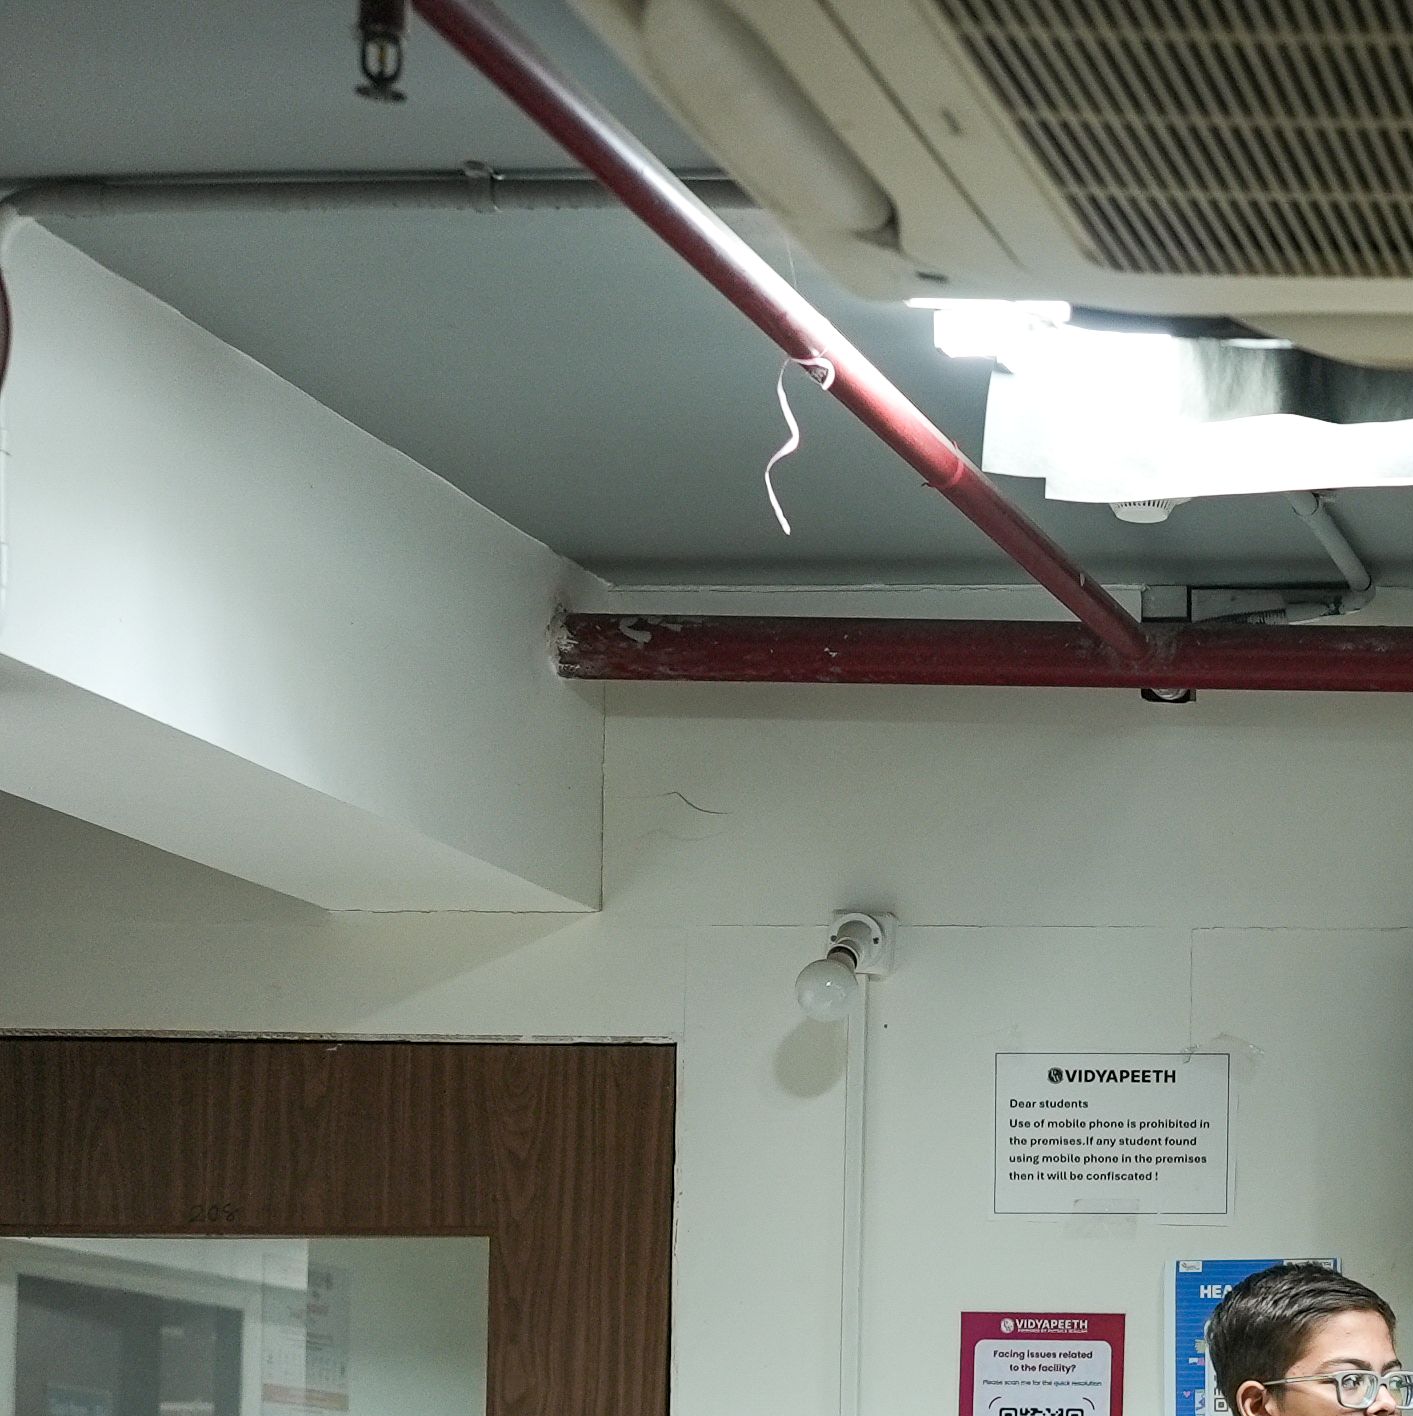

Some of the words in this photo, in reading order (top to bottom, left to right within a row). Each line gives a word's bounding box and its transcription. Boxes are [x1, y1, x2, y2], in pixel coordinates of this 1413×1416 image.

[1065, 1069, 1176, 1083] VIDYAPEETH
[1009, 1099, 1037, 1109] Dear
[1039, 1099, 1089, 1109] students
[1009, 1119, 1031, 1129] Use
[1033, 1119, 1045, 1129] of
[1047, 1119, 1086, 1129] mobile
[1088, 1119, 1124, 1131] phone
[1127, 1119, 1137, 1129] is
[1139, 1119, 1197, 1131] prohibited
[1199, 1119, 1210, 1129] in
[1009, 1136, 1028, 1146] the
[1096, 1137, 1116, 1148] any
[1118, 1136, 1162, 1146] student
[1164, 1136, 1197, 1146] found
[1009, 1154, 1039, 1165] using
[1041, 1154, 1081, 1164] mobile
[1083, 1154, 1119, 1166] phone
[1121, 1154, 1132, 1164] in
[1134, 1154, 1152, 1164] the
[1155, 1154, 1207, 1166] premises
[1009, 1171, 1034, 1181] then
[1037, 1171, 1045, 1181] it
[1047, 1171, 1067, 1181] will
[1069, 1171, 1084, 1181] be
[1086, 1171, 1152, 1181] confiscated
[1015, 1318, 1088, 1330] VIDYAPEETH
[993, 1349, 1025, 1361] Facing
[1026, 1349, 1057, 1359] issues
[1058, 1350, 1093, 1360] related
[1009, 1363, 1020, 1373] to
[1020, 1363, 1037, 1373] the
[1038, 1363, 1077, 1375] facility?
